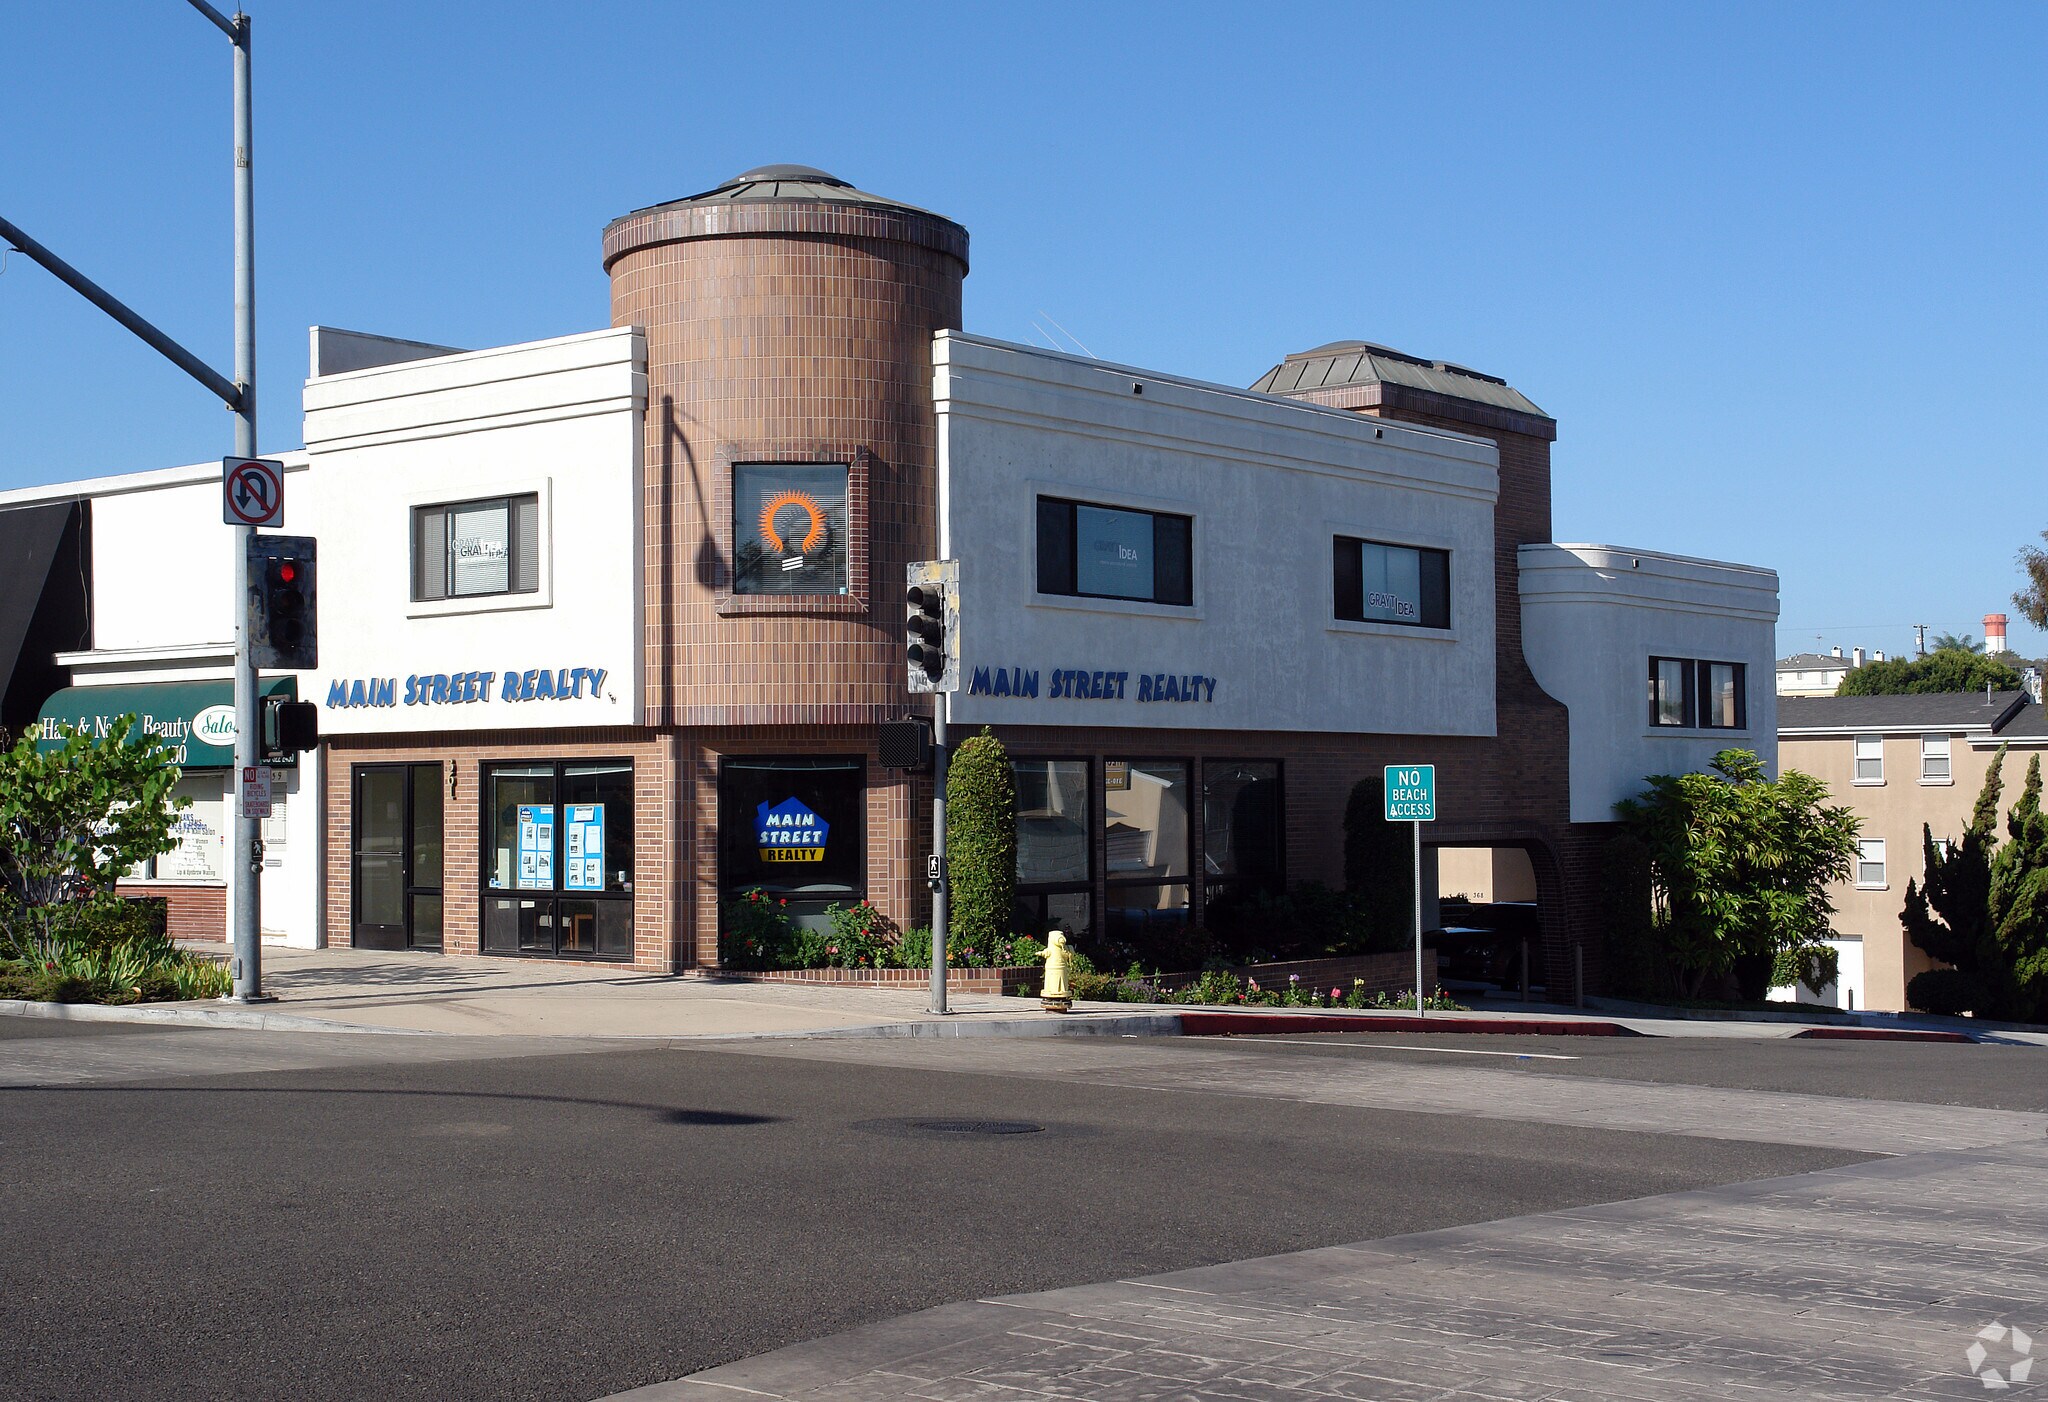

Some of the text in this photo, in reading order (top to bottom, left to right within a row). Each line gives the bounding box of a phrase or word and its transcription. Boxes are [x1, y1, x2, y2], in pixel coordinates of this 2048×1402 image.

[1368, 592, 1396, 609] GRAYT
[326, 667, 608, 709] MAIN STREET REALTY
[968, 665, 1217, 703] MAIN STREET REALTY
[143, 714, 193, 743] Beauty
[244, 769, 255, 781] NO
[1398, 770, 1421, 786] NO
[1392, 788, 1428, 801] BEACH
[1389, 803, 1431, 817] ACCESS
[765, 813, 816, 828] MAIN
[760, 830, 823, 845] STREET
[767, 849, 817, 861] REALTY
